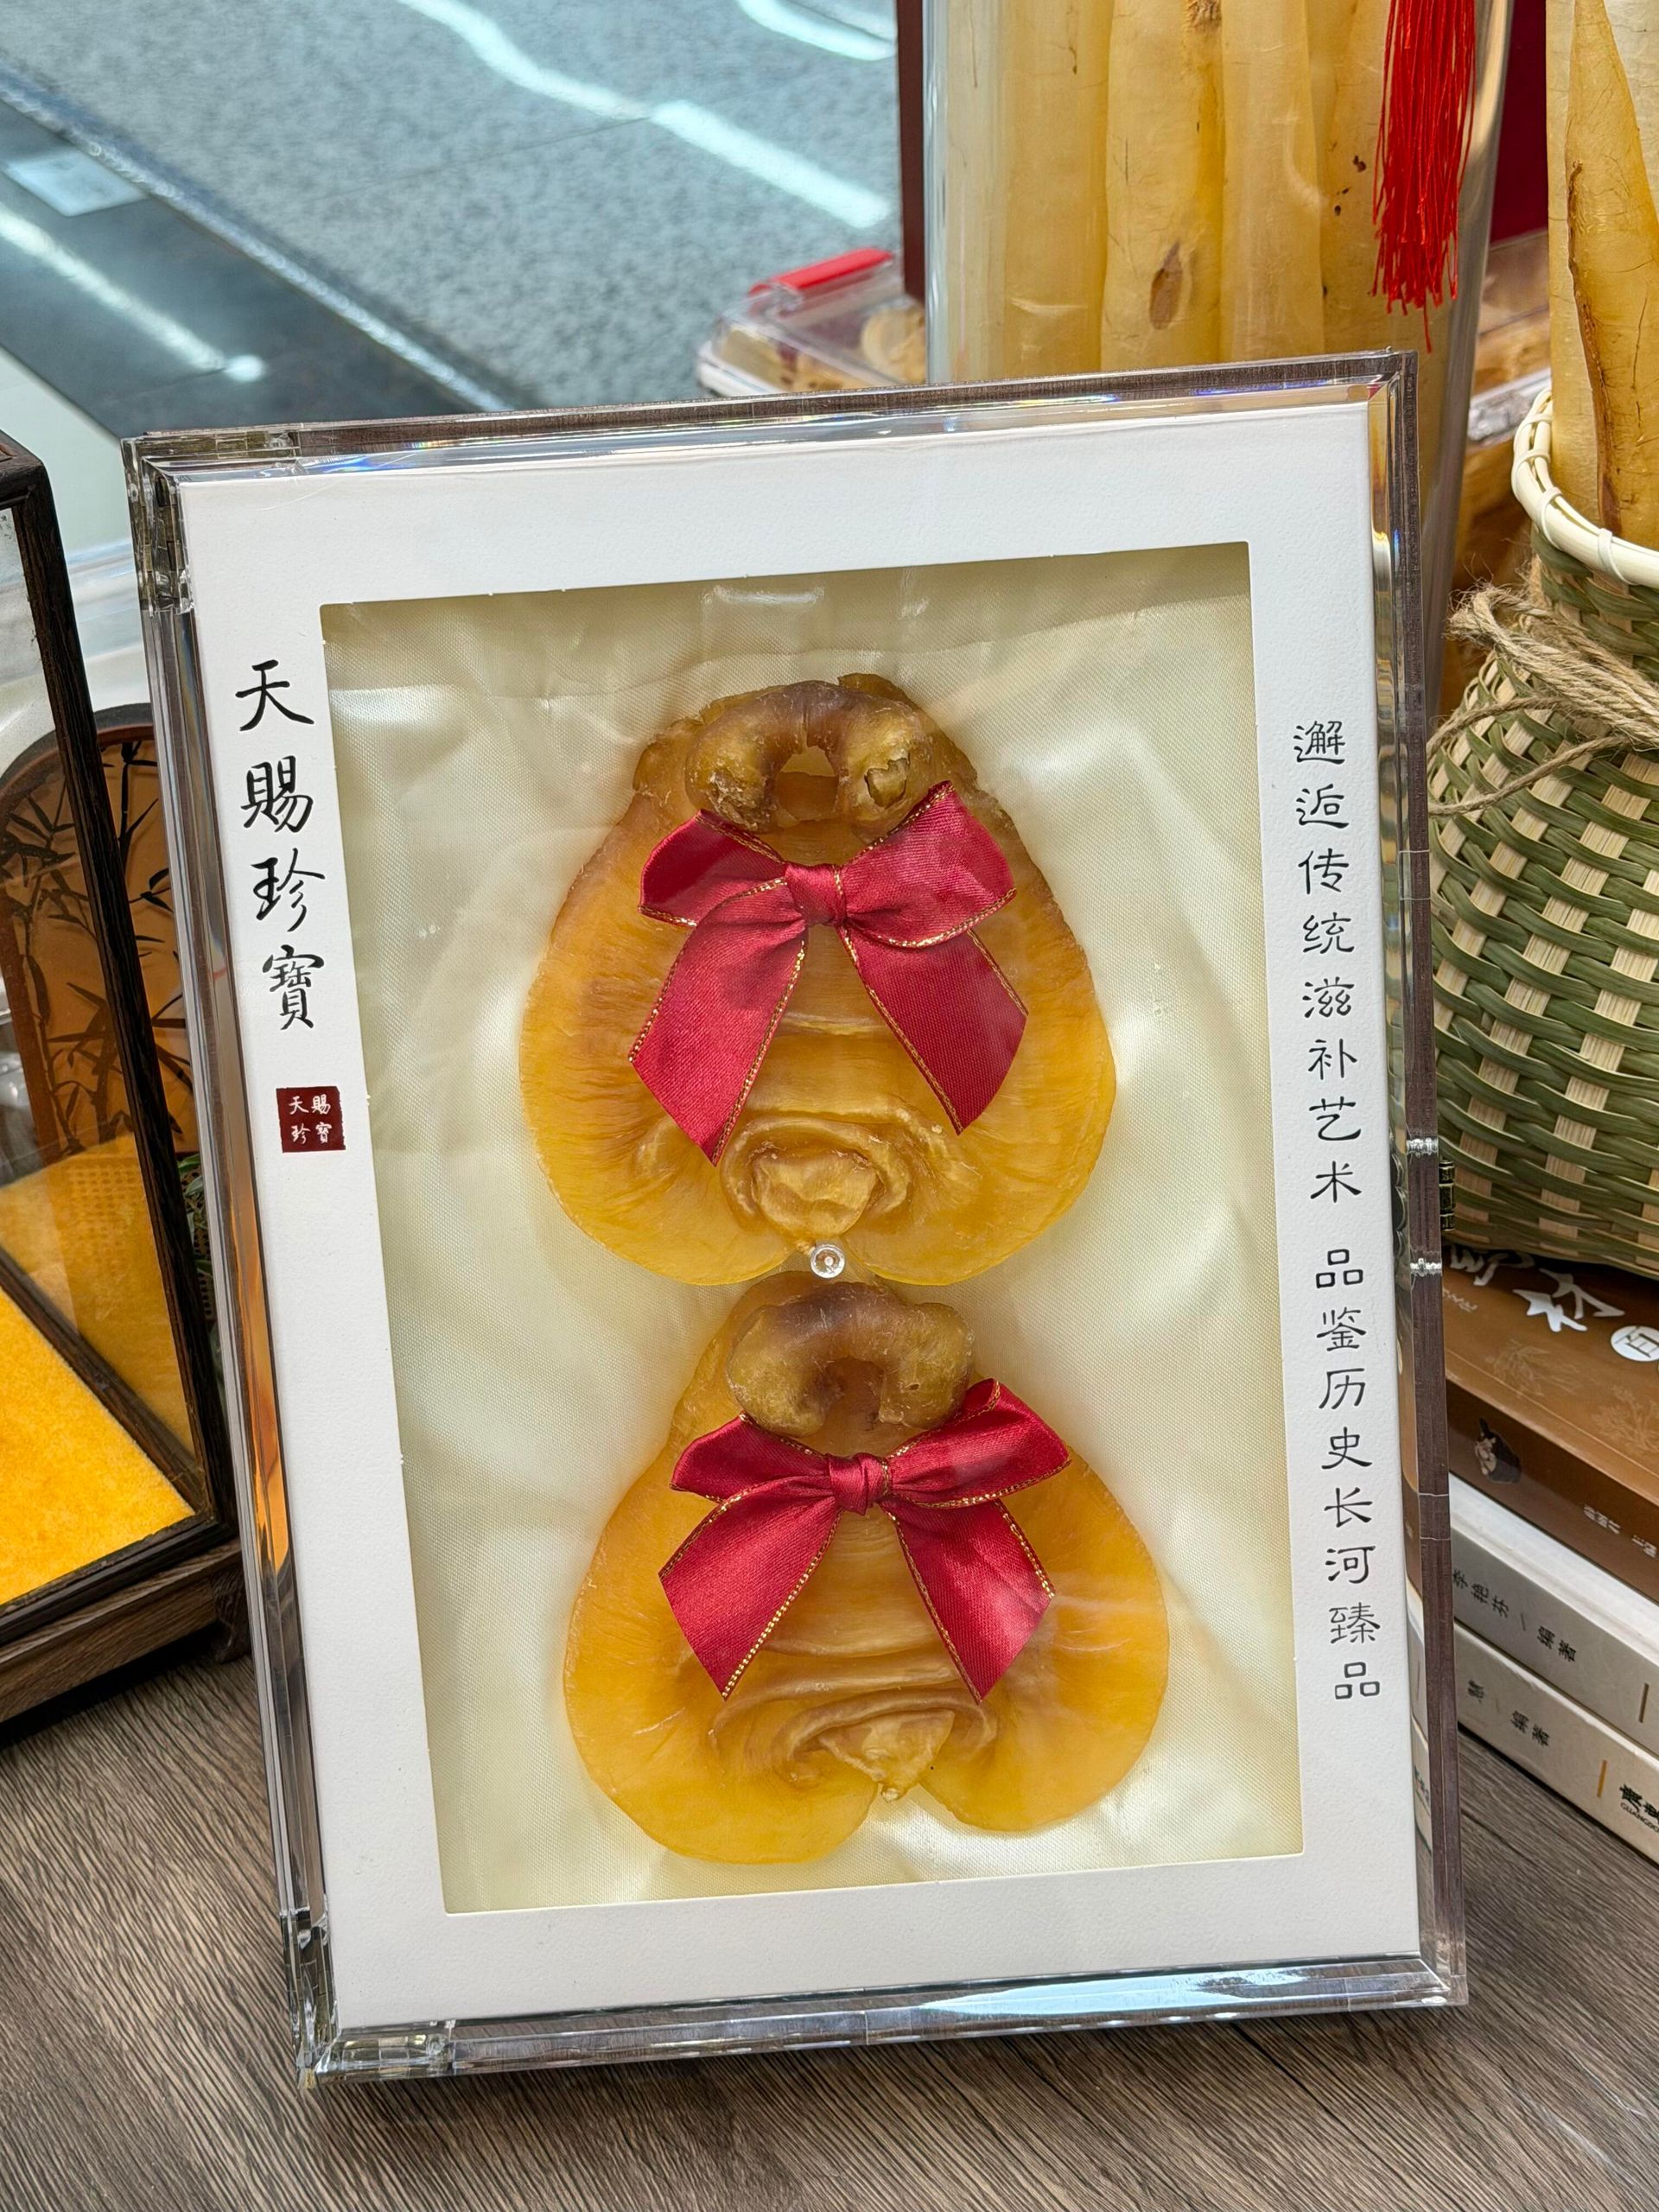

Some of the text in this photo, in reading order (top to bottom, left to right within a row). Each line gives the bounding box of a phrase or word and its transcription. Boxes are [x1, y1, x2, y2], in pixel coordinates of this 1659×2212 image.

[235, 659, 326, 1032] 天賜珍寶
[1293, 720, 1381, 1700] 邂逅传统滋补艺术 品鉴历史长河臻品
